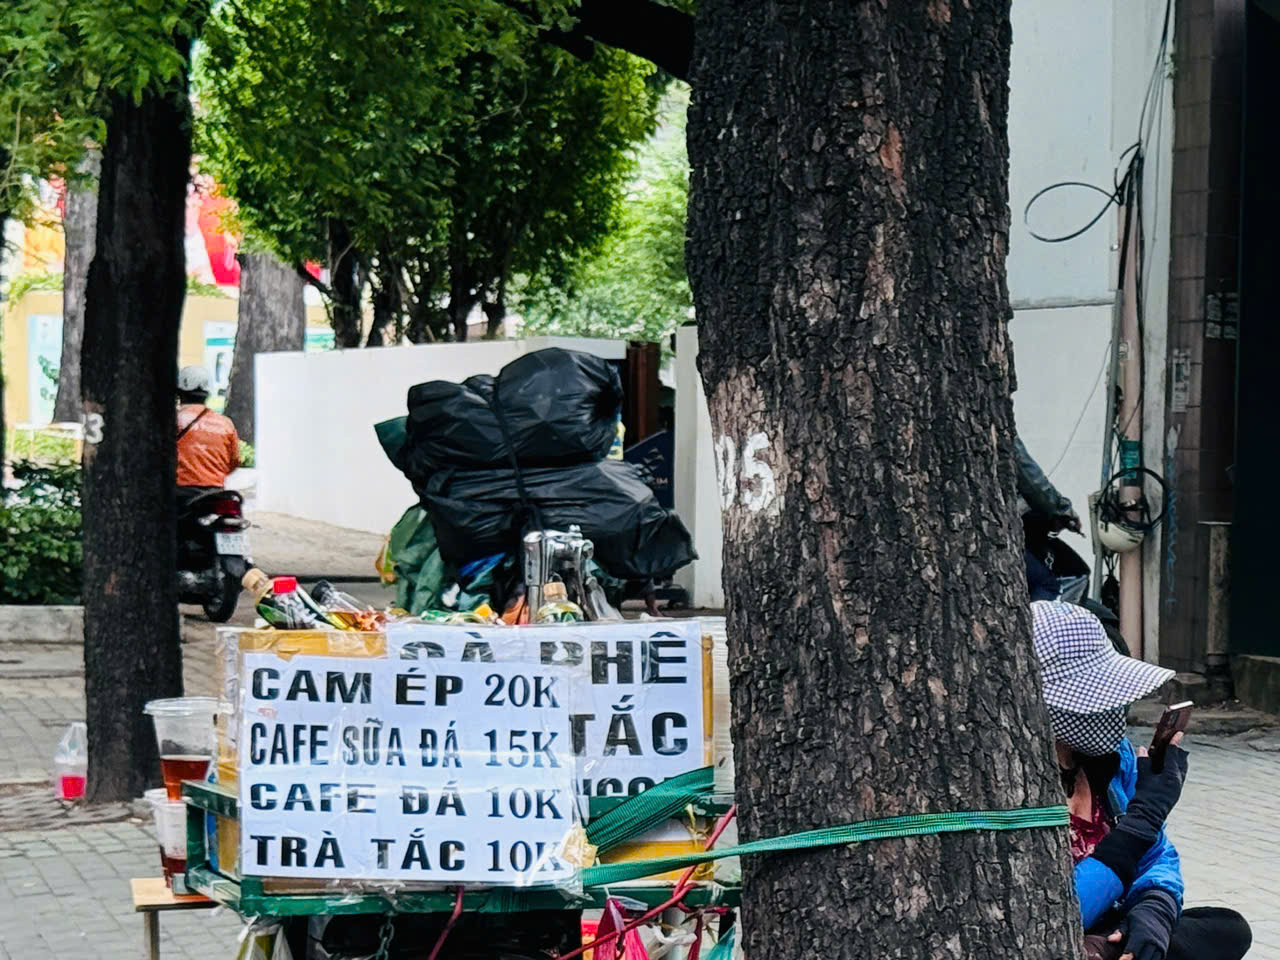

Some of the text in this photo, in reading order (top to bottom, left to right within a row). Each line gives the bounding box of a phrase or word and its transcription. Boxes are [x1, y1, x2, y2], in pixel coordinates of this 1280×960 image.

[540, 631, 688, 685] PHÊ
[252, 667, 561, 708] CAM ÉP 20K
[250, 717, 562, 768] CAFE SỮA ĐÁ 15K
[568, 694, 689, 757] TẮC
[250, 782, 376, 814] CAFE
[399, 780, 467, 817] ĐÁ
[486, 786, 563, 819] 10K
[250, 830, 345, 868] TRÀ
[370, 828, 466, 871] TẮC
